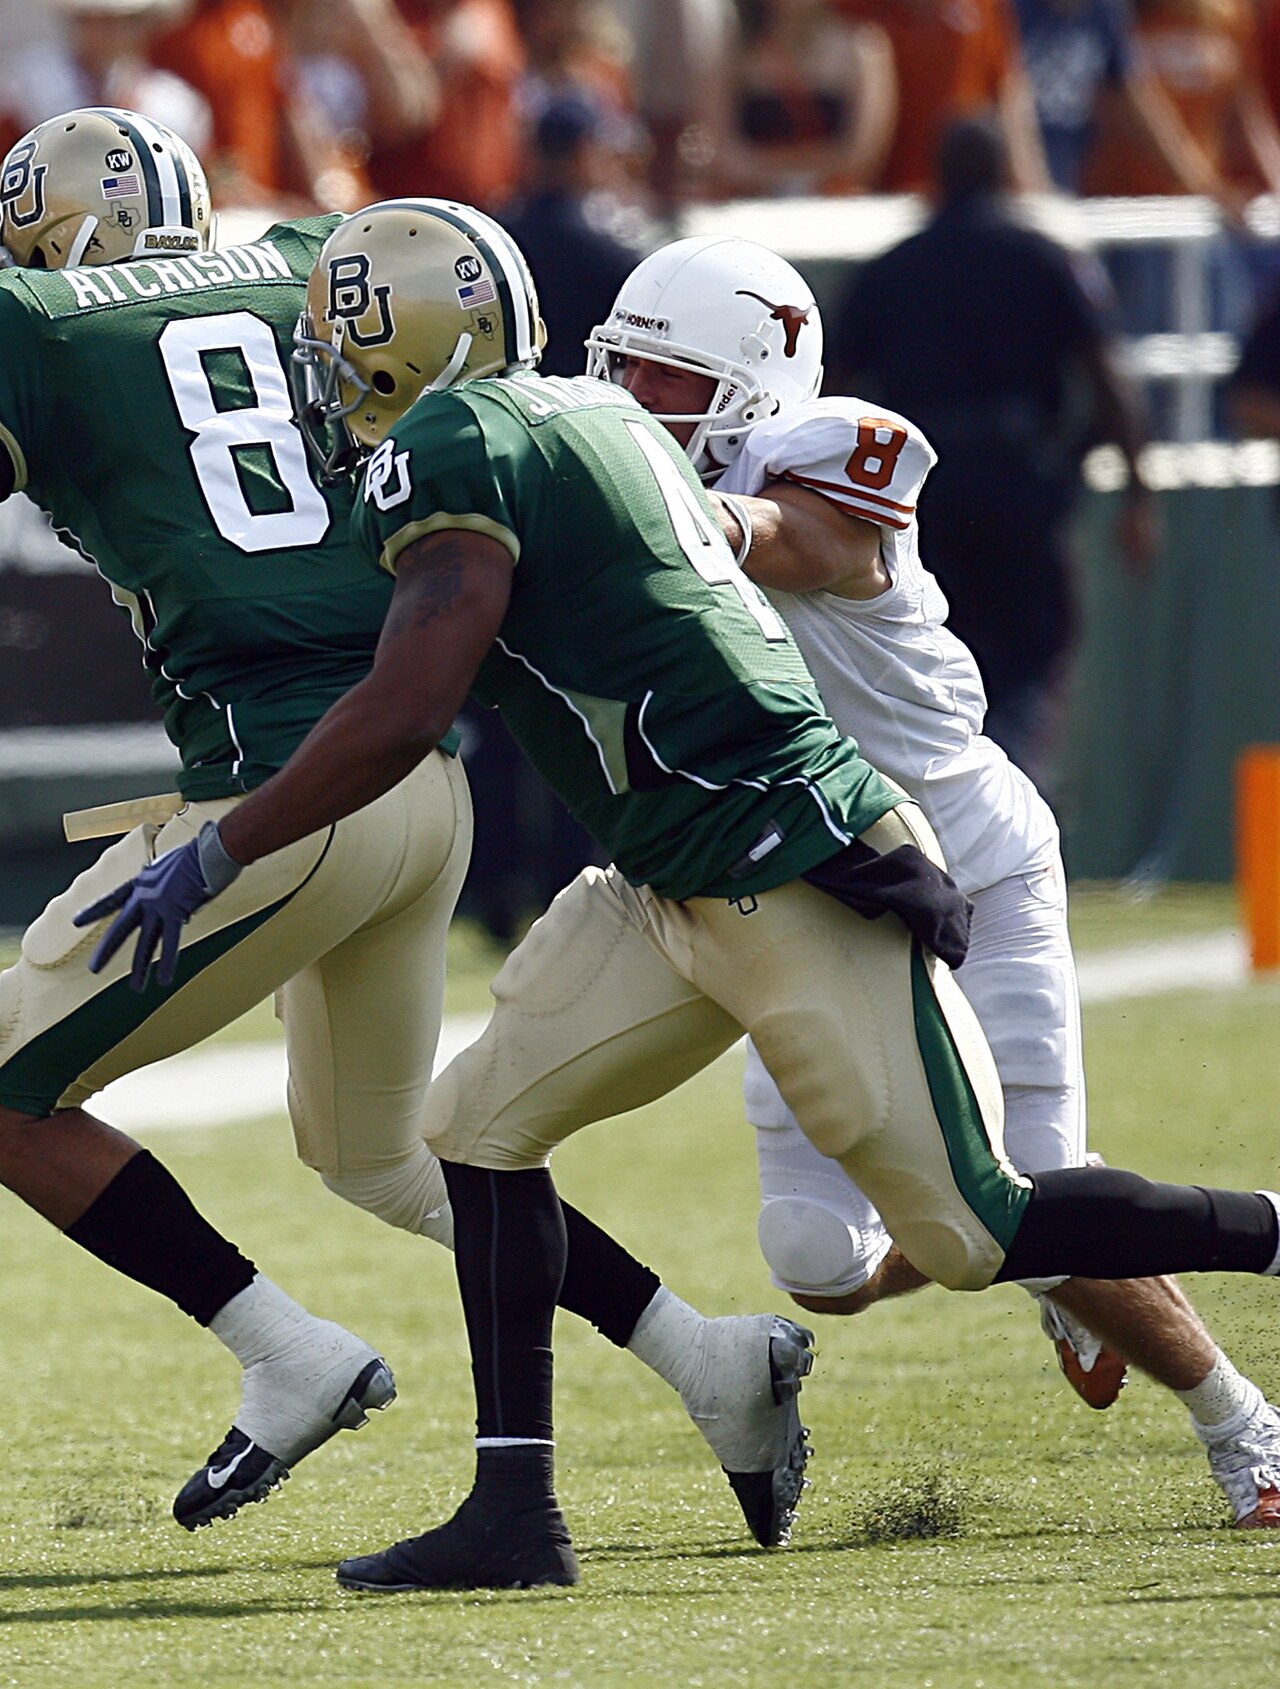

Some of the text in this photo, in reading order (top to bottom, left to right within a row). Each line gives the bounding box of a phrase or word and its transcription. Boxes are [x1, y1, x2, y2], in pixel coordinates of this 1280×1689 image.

[107, 152, 130, 169] KW
[59, 241, 293, 308] ATCHISON
[326, 252, 396, 349] BU
[456, 259, 479, 279] KW
[157, 310, 331, 553] 8
[844, 417, 908, 490] 8
[364, 439, 411, 511] BU
[621, 418, 788, 643] 4
